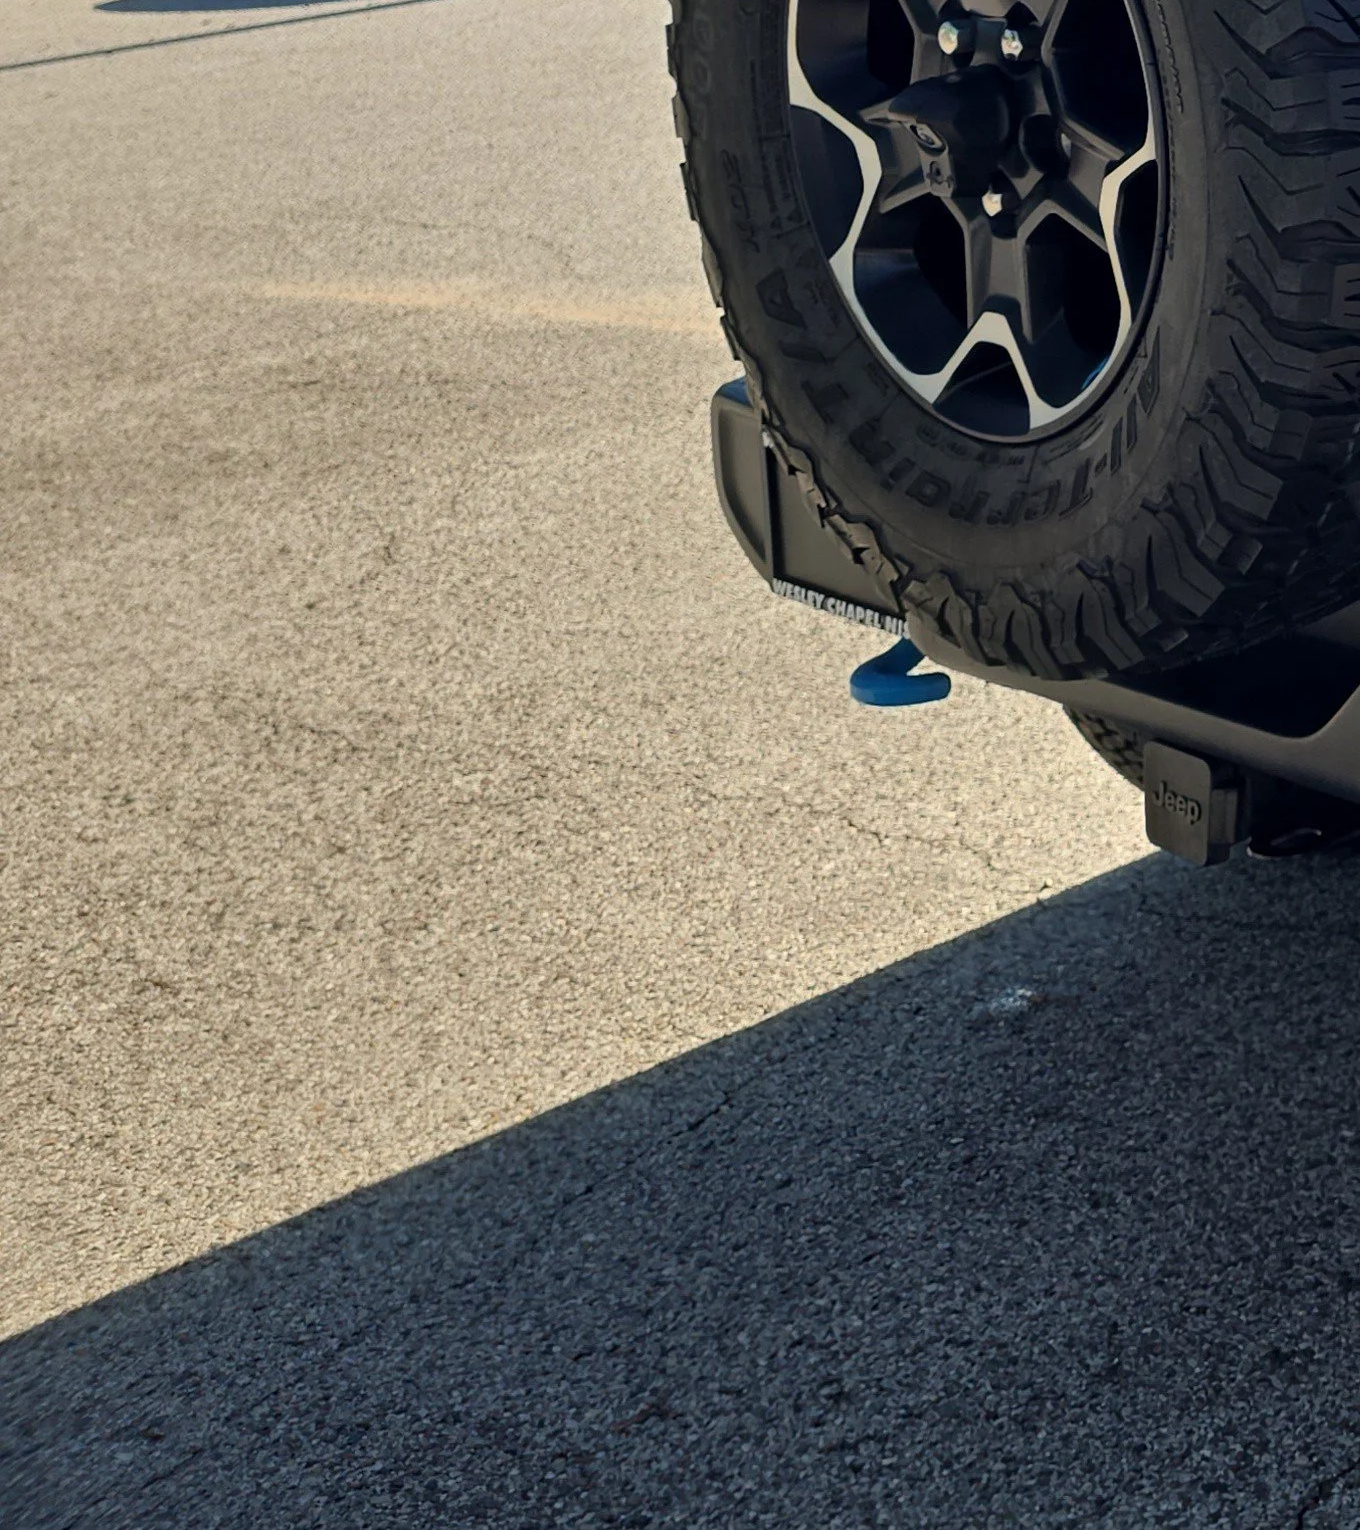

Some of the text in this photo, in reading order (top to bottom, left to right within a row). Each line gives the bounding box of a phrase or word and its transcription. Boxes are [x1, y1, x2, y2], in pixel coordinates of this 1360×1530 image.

[772, 577, 825, 610] WESLEY
[826, 596, 882, 630] CHAPEL
[1152, 779, 1202, 826] Jeep
